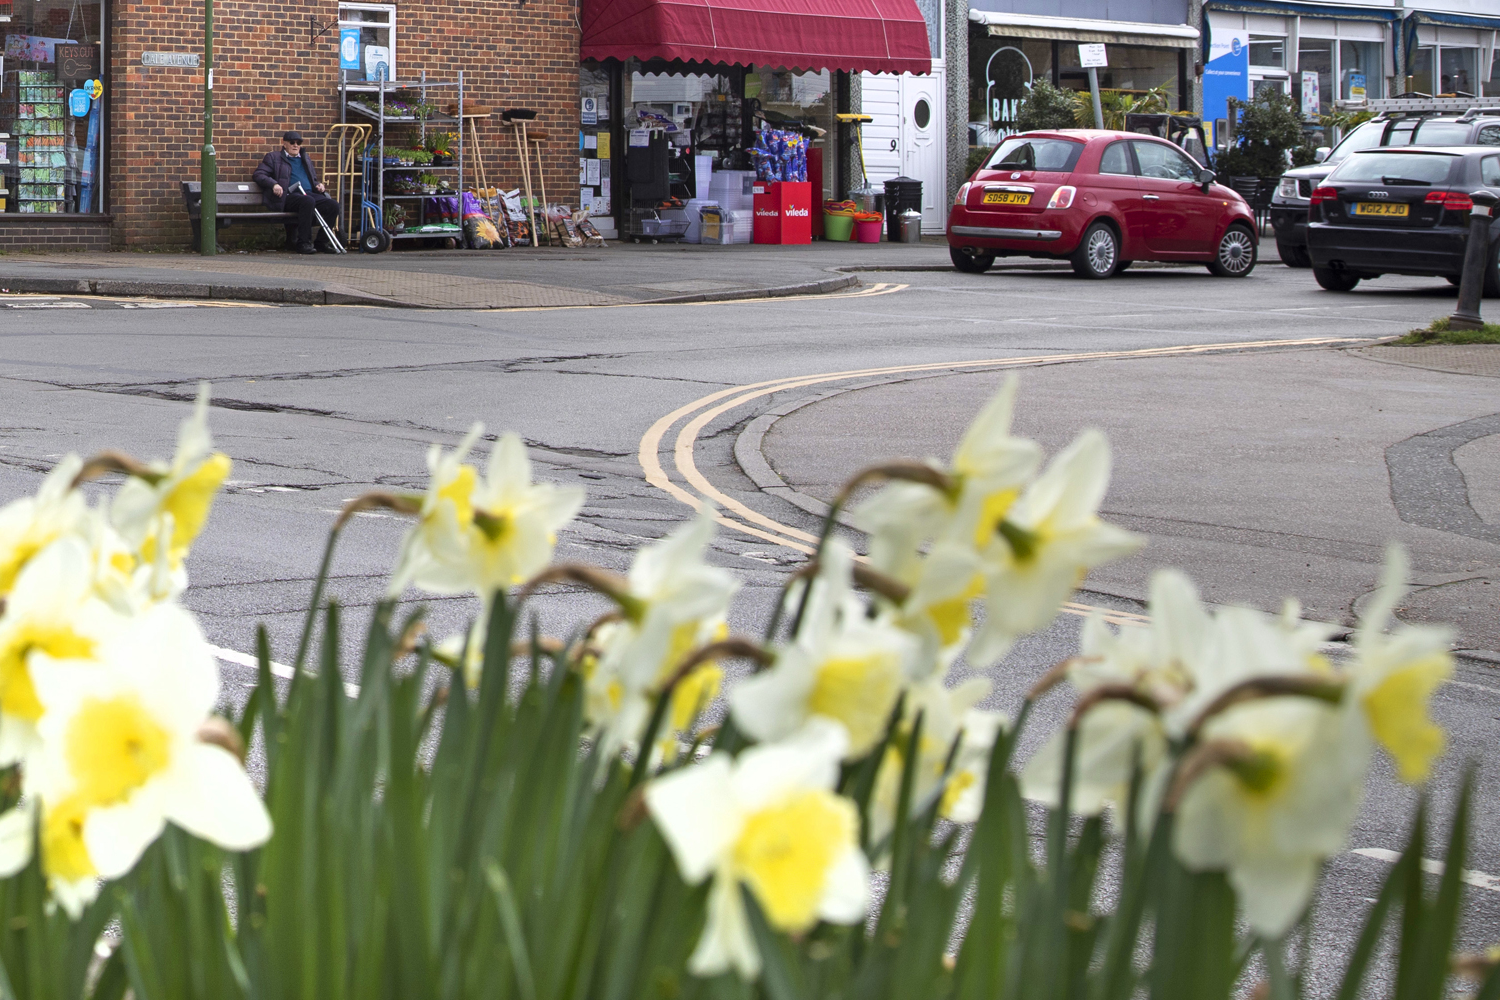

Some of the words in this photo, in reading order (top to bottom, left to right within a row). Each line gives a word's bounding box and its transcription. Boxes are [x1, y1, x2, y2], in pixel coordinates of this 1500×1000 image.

[60, 46, 79, 58] KEYS
[80, 46, 95, 58] CUT
[144, 53, 164, 65] DALE
[168, 55, 198, 66] AVENUE
[890, 139, 896, 152] 9
[987, 194, 1008, 202] SD58
[1010, 195, 1026, 203] JYR
[785, 208, 808, 216] vileda
